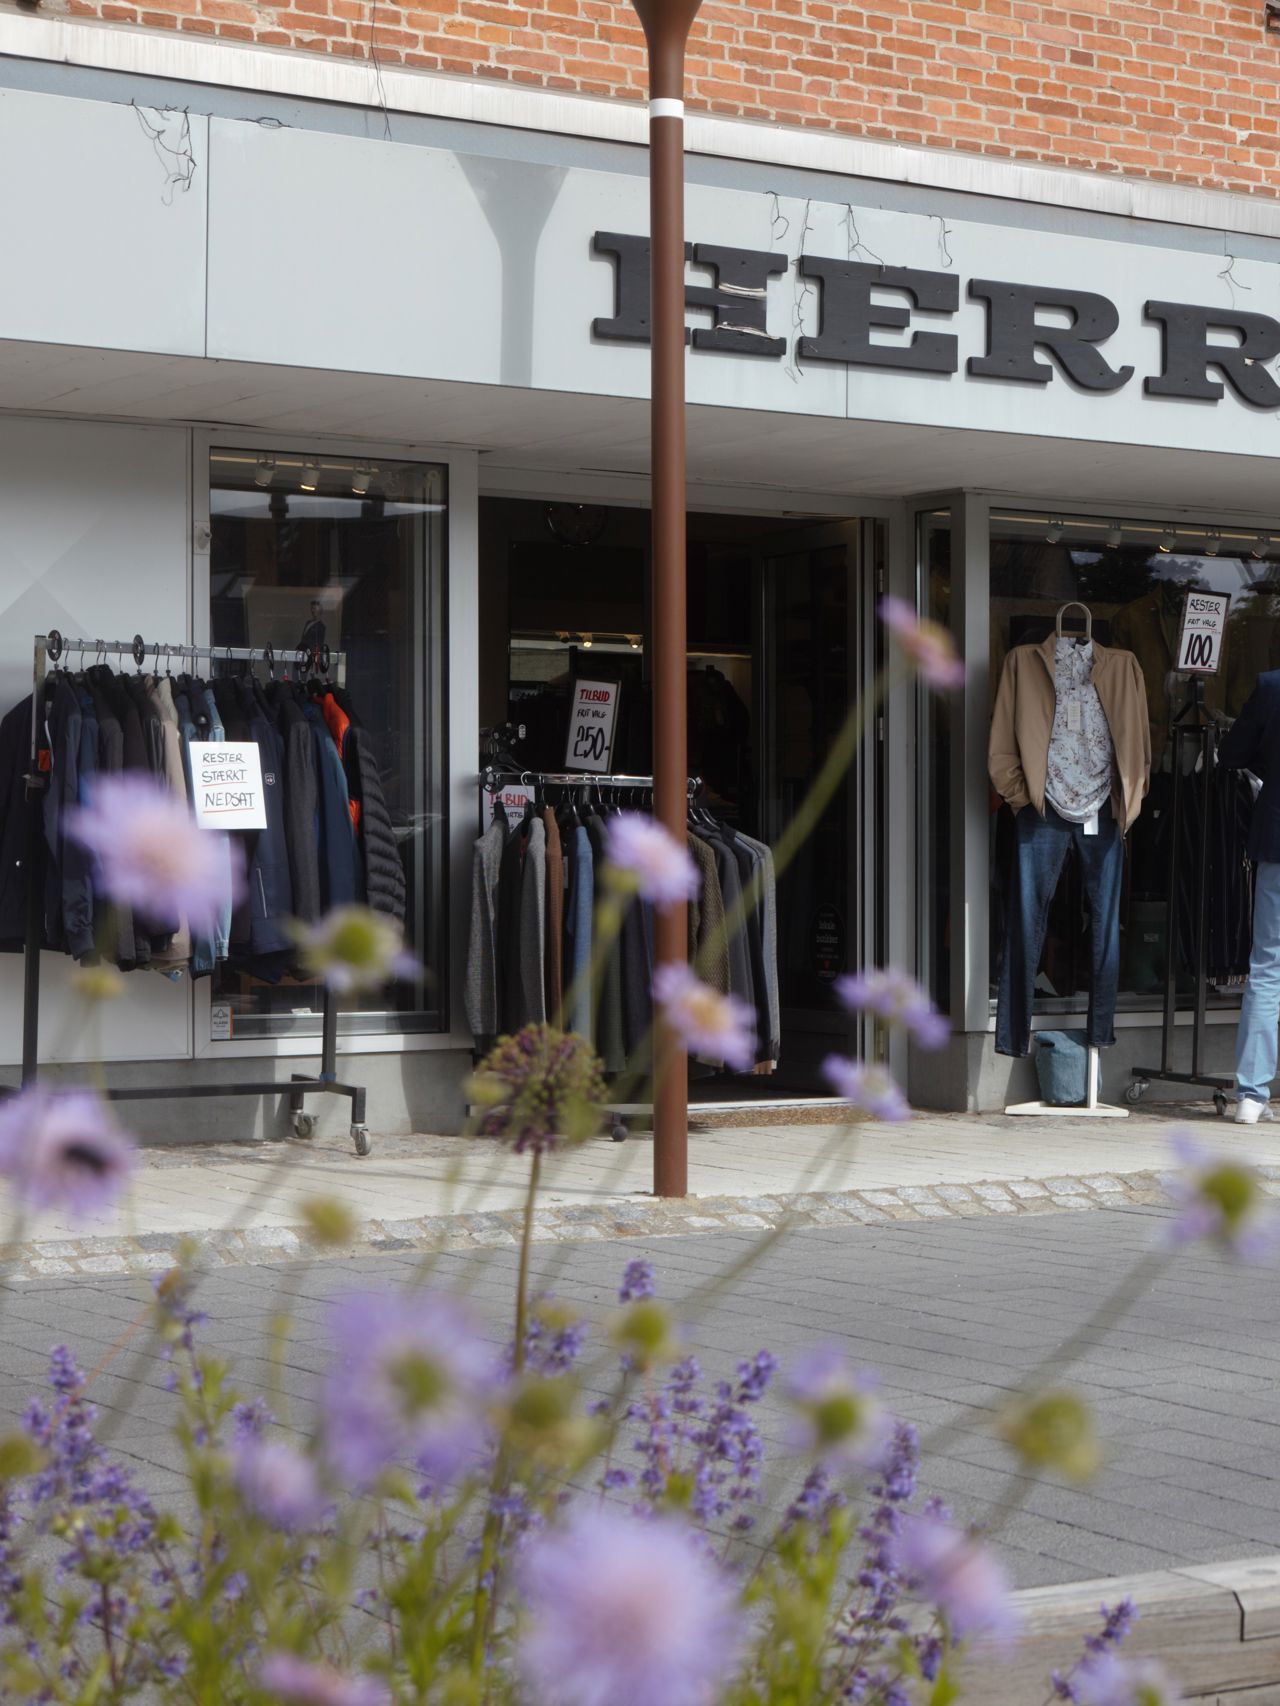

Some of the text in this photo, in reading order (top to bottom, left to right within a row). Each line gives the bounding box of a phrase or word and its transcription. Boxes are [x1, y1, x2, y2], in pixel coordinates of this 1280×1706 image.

[1189, 598, 1221, 615] RESTER
[1202, 619, 1217, 628] VALG
[579, 689, 610, 703] TILBUD
[577, 708, 590, 718] FRIT
[202, 752, 246, 764] RESTER
[202, 769, 249, 783] STÆRKT
[205, 792, 256, 808] NEDSAT
